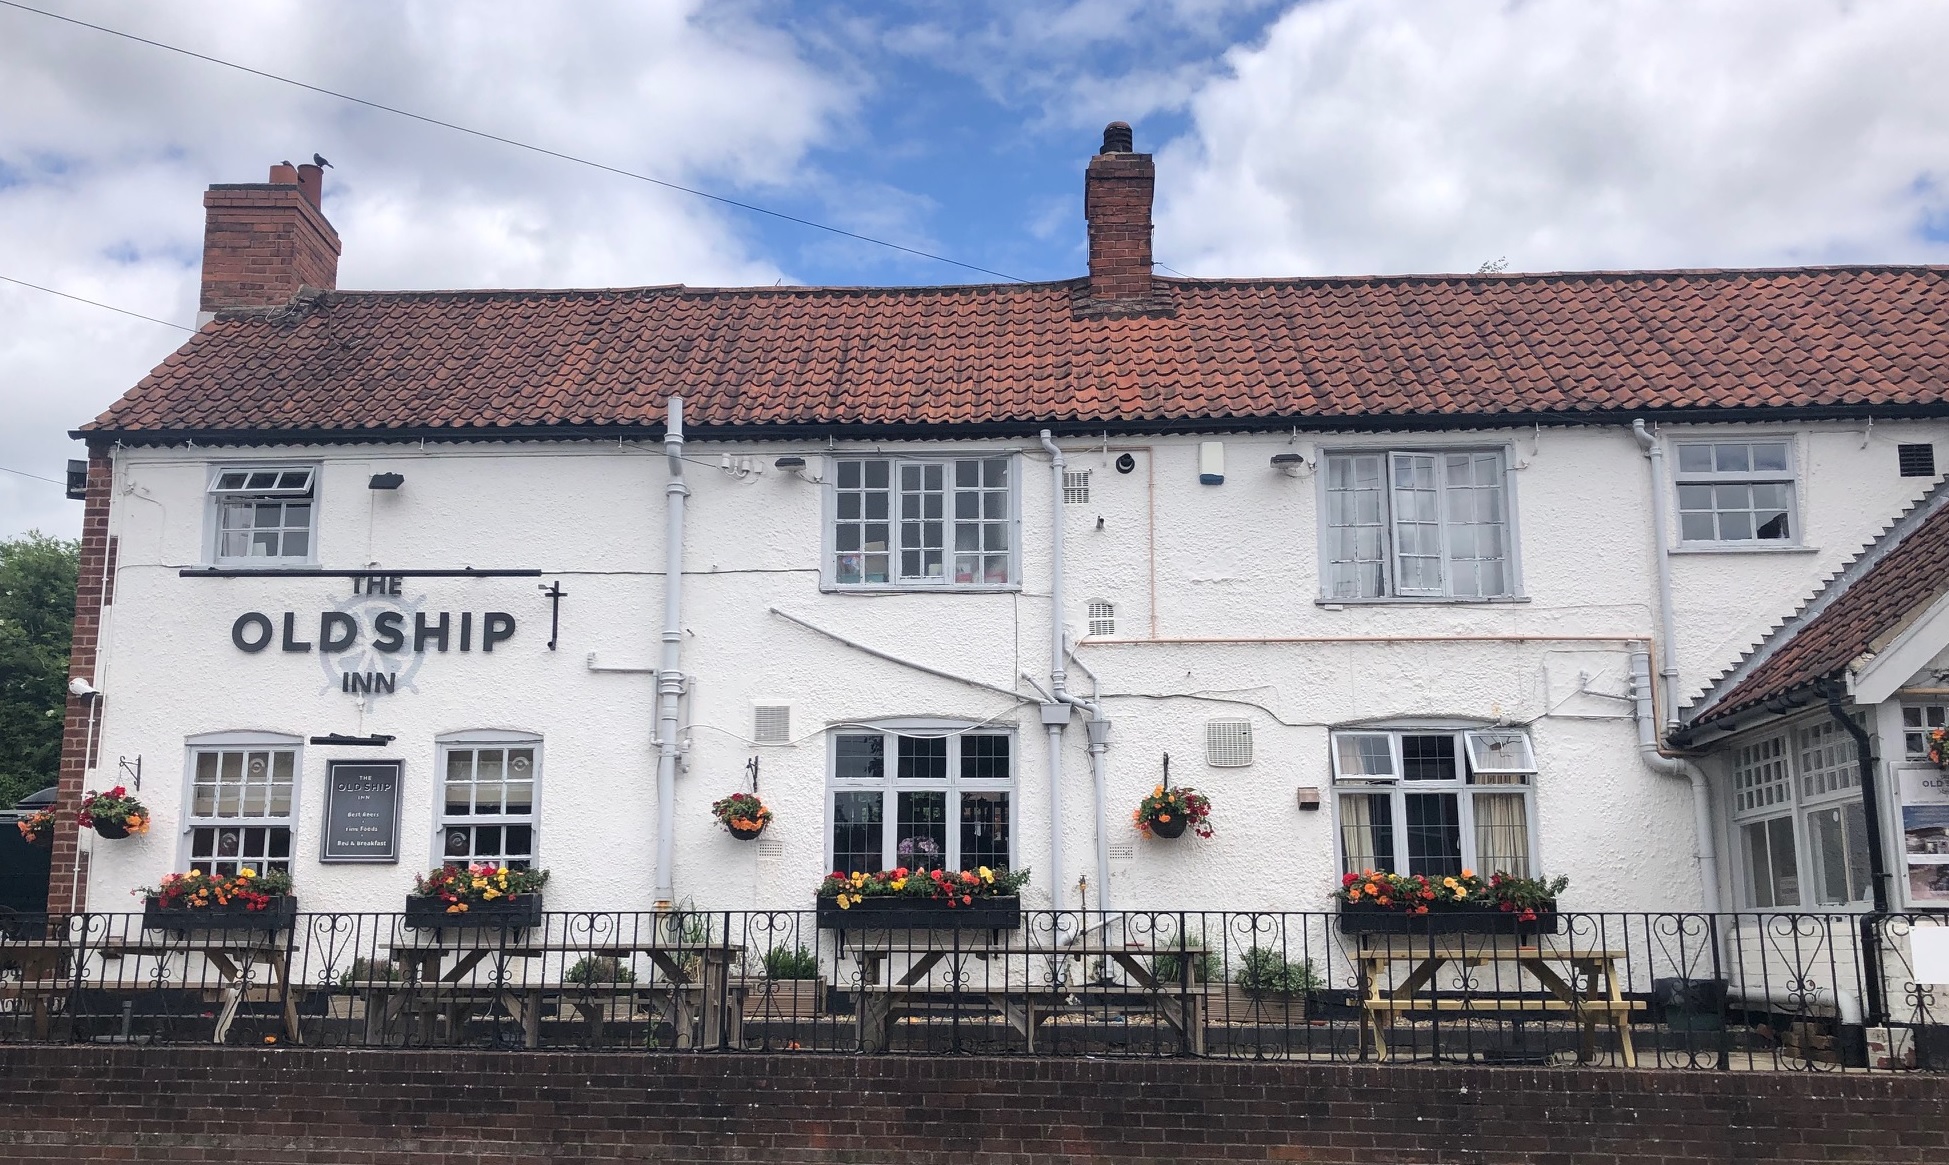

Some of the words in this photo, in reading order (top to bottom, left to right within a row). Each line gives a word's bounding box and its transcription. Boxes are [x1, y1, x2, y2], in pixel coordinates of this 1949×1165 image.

[352, 577, 402, 594] THE
[231, 611, 358, 653] OLD
[372, 611, 516, 652] SHIP
[342, 671, 396, 693] INN
[338, 783, 361, 792] OLD
[364, 783, 392, 792] SHIP
[1922, 780, 1943, 788] OLD
